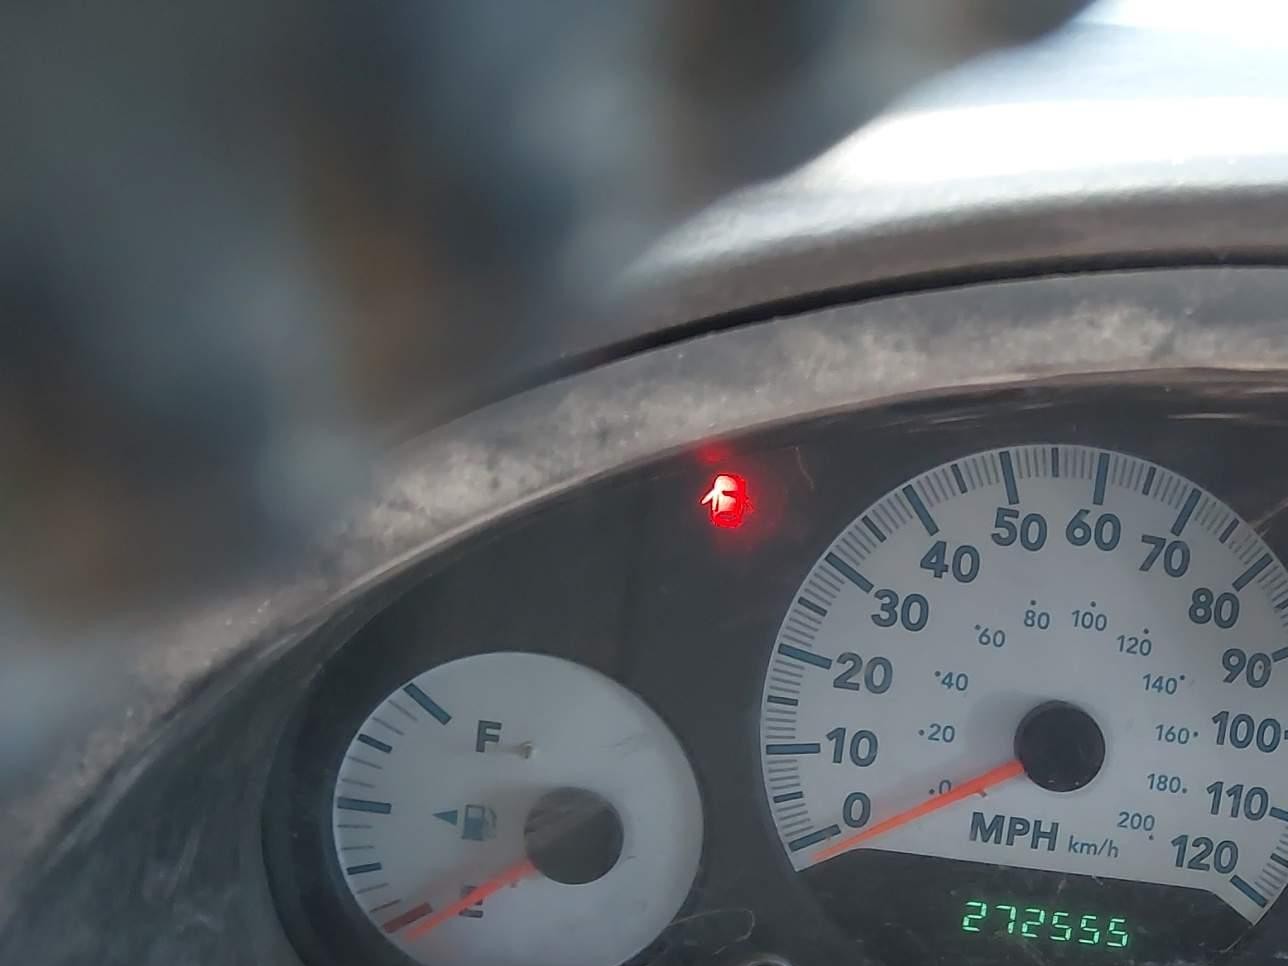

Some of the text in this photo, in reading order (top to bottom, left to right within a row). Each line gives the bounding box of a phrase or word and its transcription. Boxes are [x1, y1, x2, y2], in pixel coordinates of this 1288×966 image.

[991, 508, 1048, 551] 50
[1065, 509, 1121, 551] 60
[920, 541, 980, 583] 40
[1139, 535, 1191, 578] 70
[872, 589, 929, 632] 30
[1023, 609, 1050, 630] 80
[1072, 610, 1108, 631] 100
[1188, 588, 1240, 629] 80
[978, 628, 1006, 648] 60
[1117, 635, 1152, 656] 120
[832, 652, 894, 694] 20
[940, 672, 969, 691] 40
[1143, 674, 1178, 695] 140
[1221, 649, 1272, 688] 90
[476, 720, 502, 752] F
[826, 728, 878, 767] 10
[928, 724, 955, 743] 20
[1155, 725, 1190, 744] 160
[1212, 712, 1281, 753] 100
[1147, 774, 1183, 793] 180
[1206, 782, 1268, 821] 110
[843, 792, 871, 828] 0
[1117, 811, 1155, 833] 200
[969, 811, 1120, 860] MPH km/h
[1171, 834, 1238, 874] 120
[962, 901, 1129, 949] 272555
